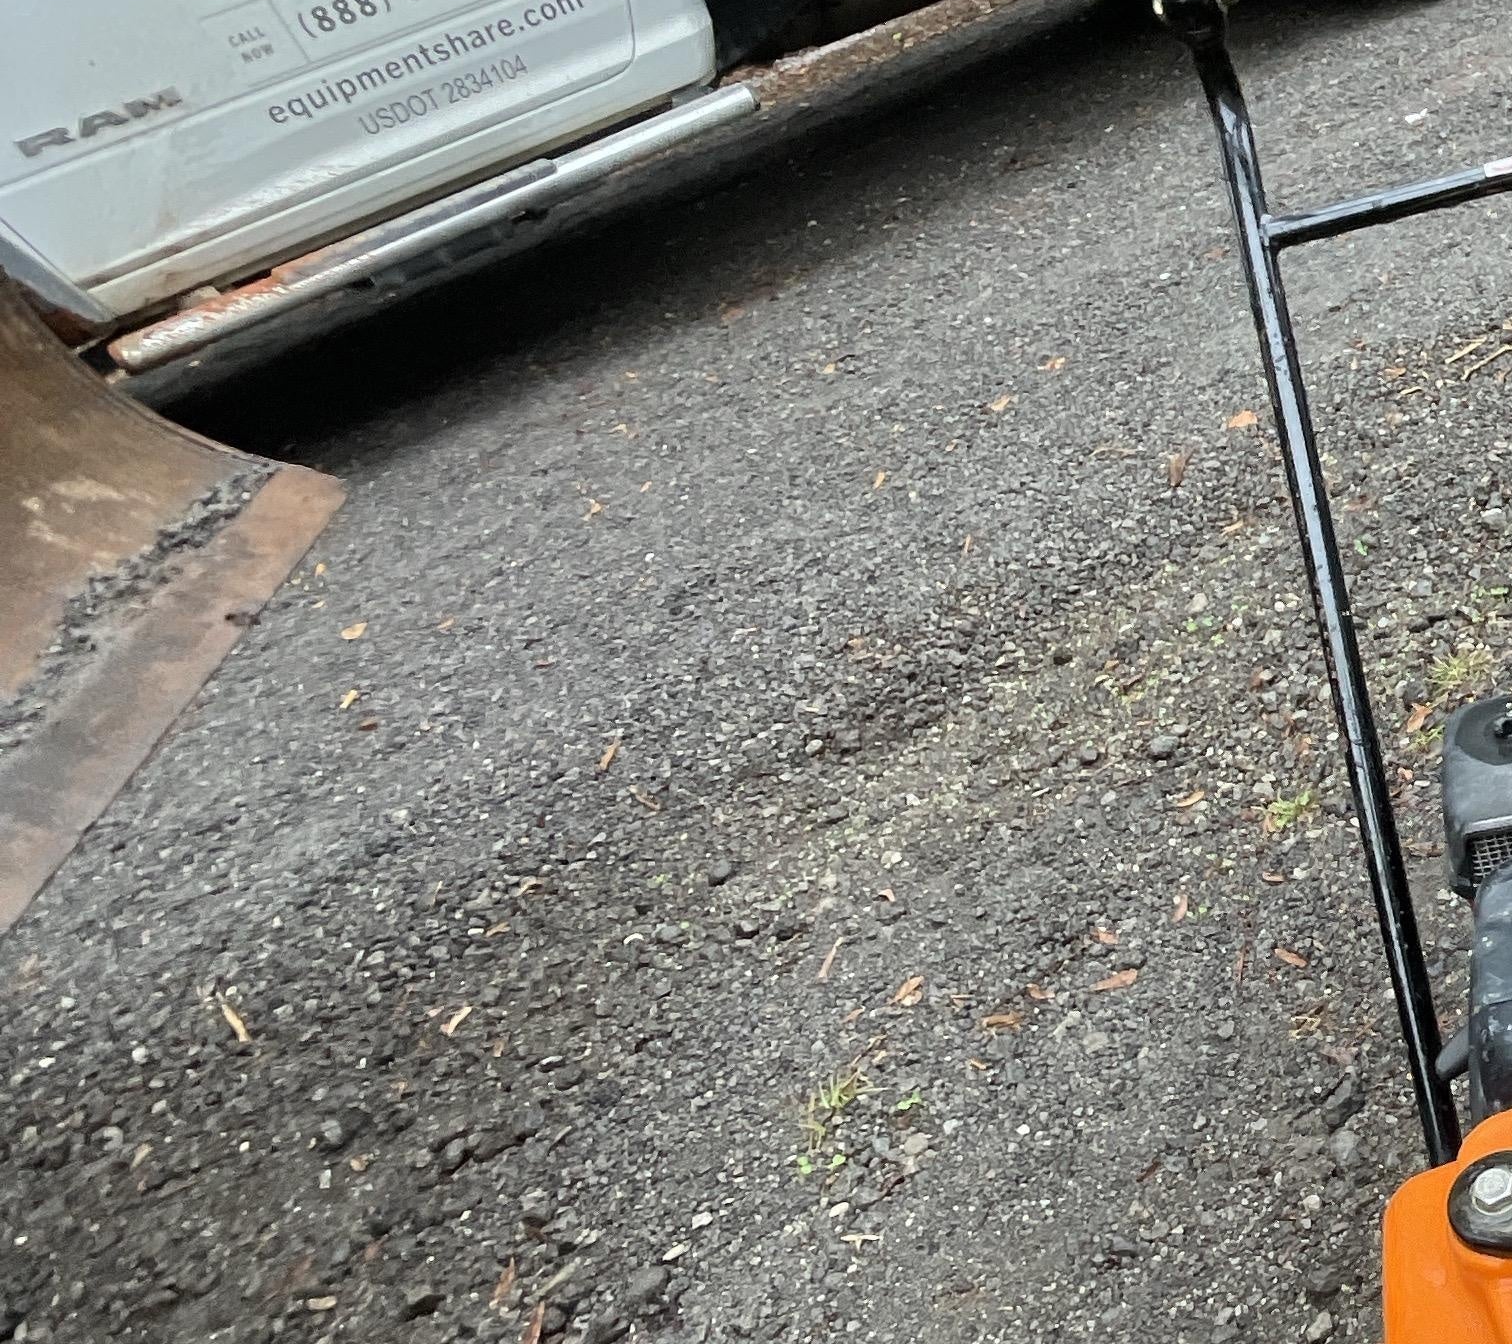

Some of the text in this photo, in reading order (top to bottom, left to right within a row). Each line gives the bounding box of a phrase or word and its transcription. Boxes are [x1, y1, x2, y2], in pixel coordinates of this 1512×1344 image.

[228, 26, 266, 48] CALL
[241, 43, 275, 63] NOW
[358, 54, 528, 135] USDOT 2834104
[13, 86, 183, 157] RAM
